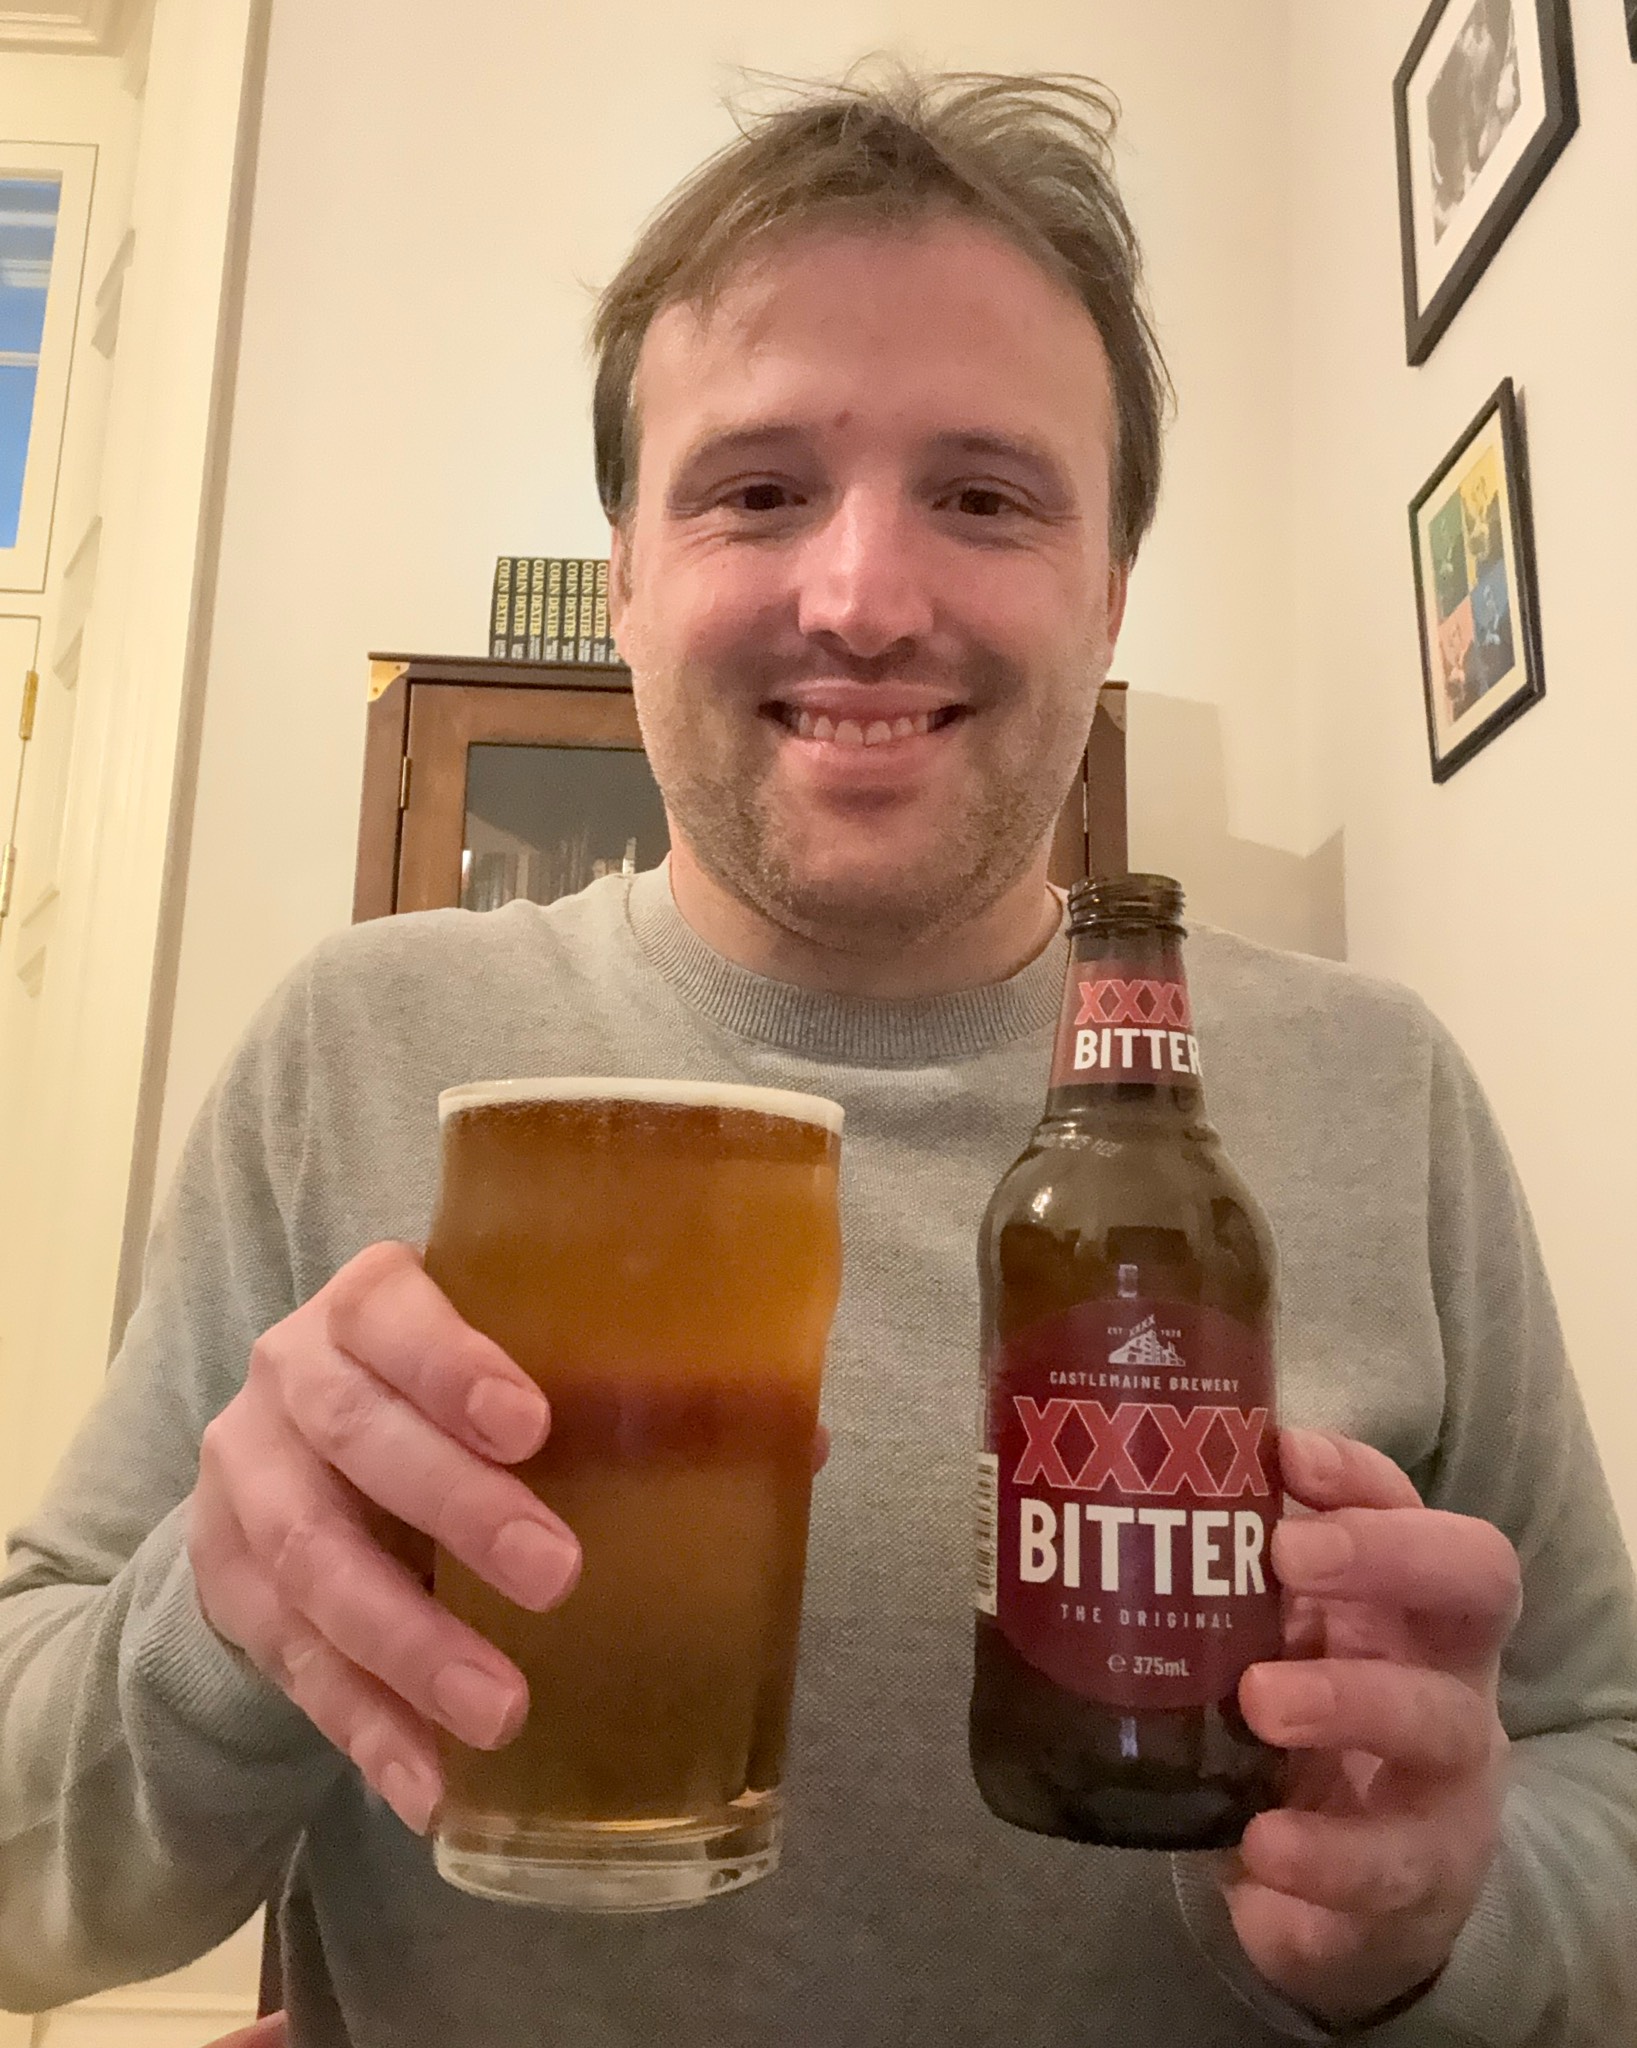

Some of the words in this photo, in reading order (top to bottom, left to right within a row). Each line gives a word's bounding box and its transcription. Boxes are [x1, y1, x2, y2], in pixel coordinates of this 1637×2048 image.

[498, 559, 511, 593] COLIN
[515, 559, 529, 593] COLIN
[532, 559, 545, 592] COLIN
[548, 561, 562, 595] COLIN
[565, 561, 579, 594] COLIN
[581, 561, 594, 594] COLIN
[596, 562, 608, 596] COLIN
[495, 594, 509, 635] DEXTER
[513, 595, 527, 637] DEXTER
[529, 594, 543, 636] DEXTER
[546, 597, 560, 639] DEXTER
[563, 596, 577, 639] DEXTER
[579, 596, 593, 639] DEXTER
[594, 597, 607, 639] DEXTER
[1074, 1028, 1203, 1077] BITTER
[1050, 1371, 1162, 1390] CASTLEMAINE
[1169, 1376, 1239, 1392] BREWERY
[1012, 1396, 1270, 1497] XXXX
[1020, 1498, 1266, 1596] BITTER
[1061, 1604, 1102, 1623] THE
[1120, 1609, 1233, 1629] ORIGINAL
[1133, 1655, 1190, 1677] 375mL
